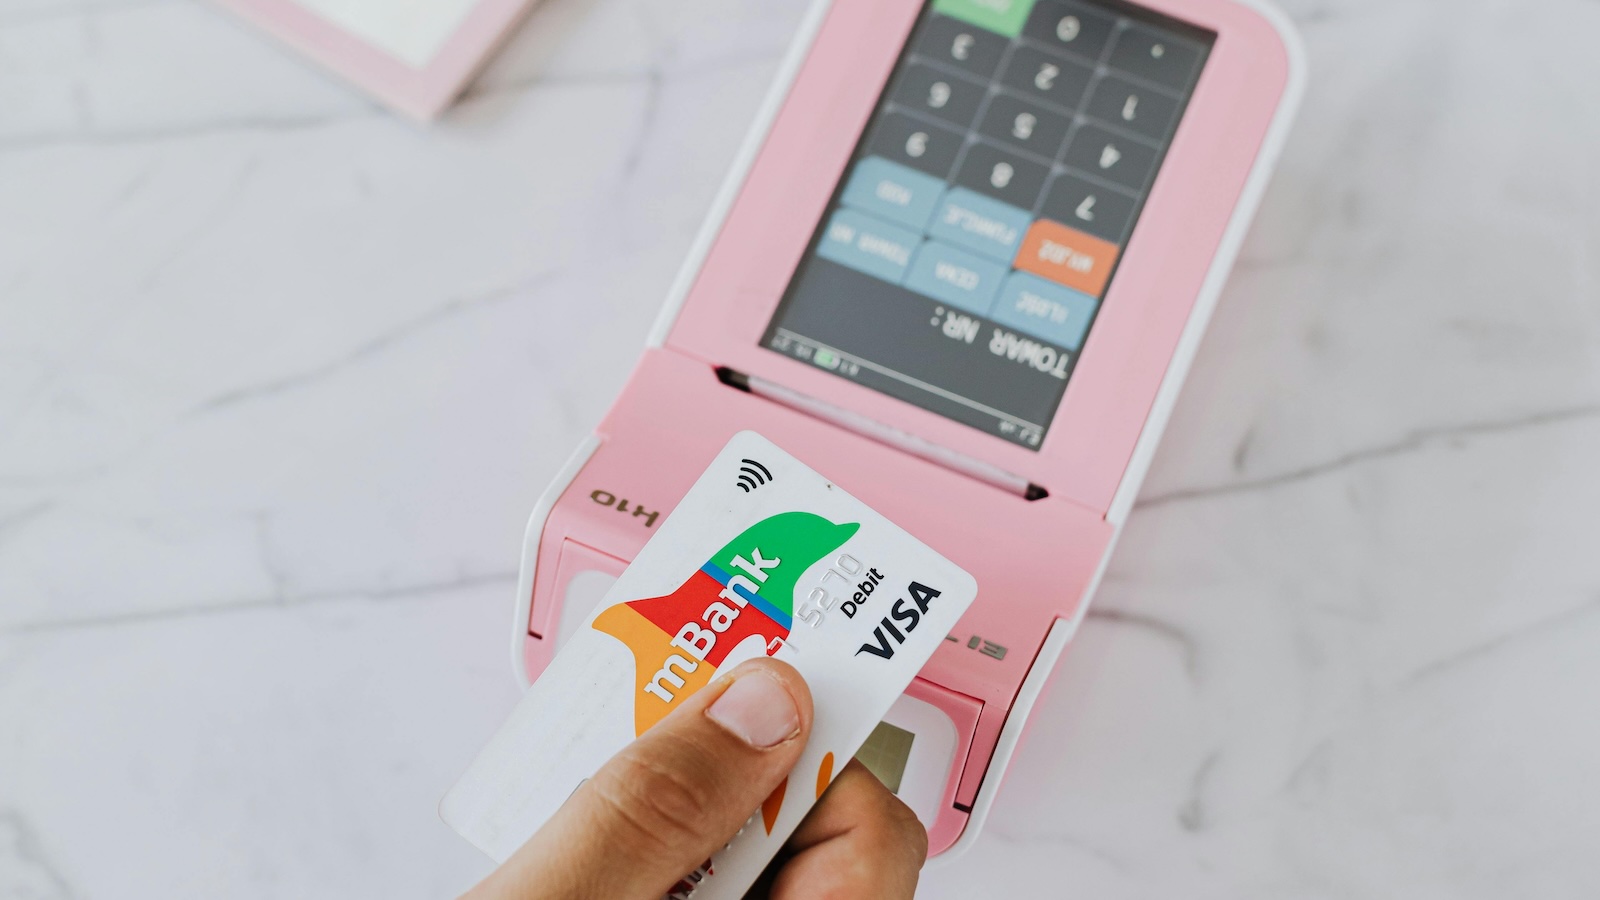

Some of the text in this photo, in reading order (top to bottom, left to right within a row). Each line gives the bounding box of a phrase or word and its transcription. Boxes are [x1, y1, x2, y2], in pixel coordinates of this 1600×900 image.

[1057, 15, 1080, 42] 0
[951, 33, 975, 60] 3
[1034, 62, 1060, 90] 2
[927, 81, 951, 108] 6
[1122, 94, 1139, 121] 1
[1012, 112, 1037, 140] 5
[905, 131, 929, 158] 9
[1099, 143, 1122, 169] 4
[990, 162, 1014, 188] 8
[1075, 194, 1097, 221] 7
[930, 306, 1070, 380] TOWAR NR:
[795, 552, 864, 629] 5270
[840, 566, 885, 620] Debit
[644, 546, 781, 703] mBank
[854, 580, 942, 661] VISA
